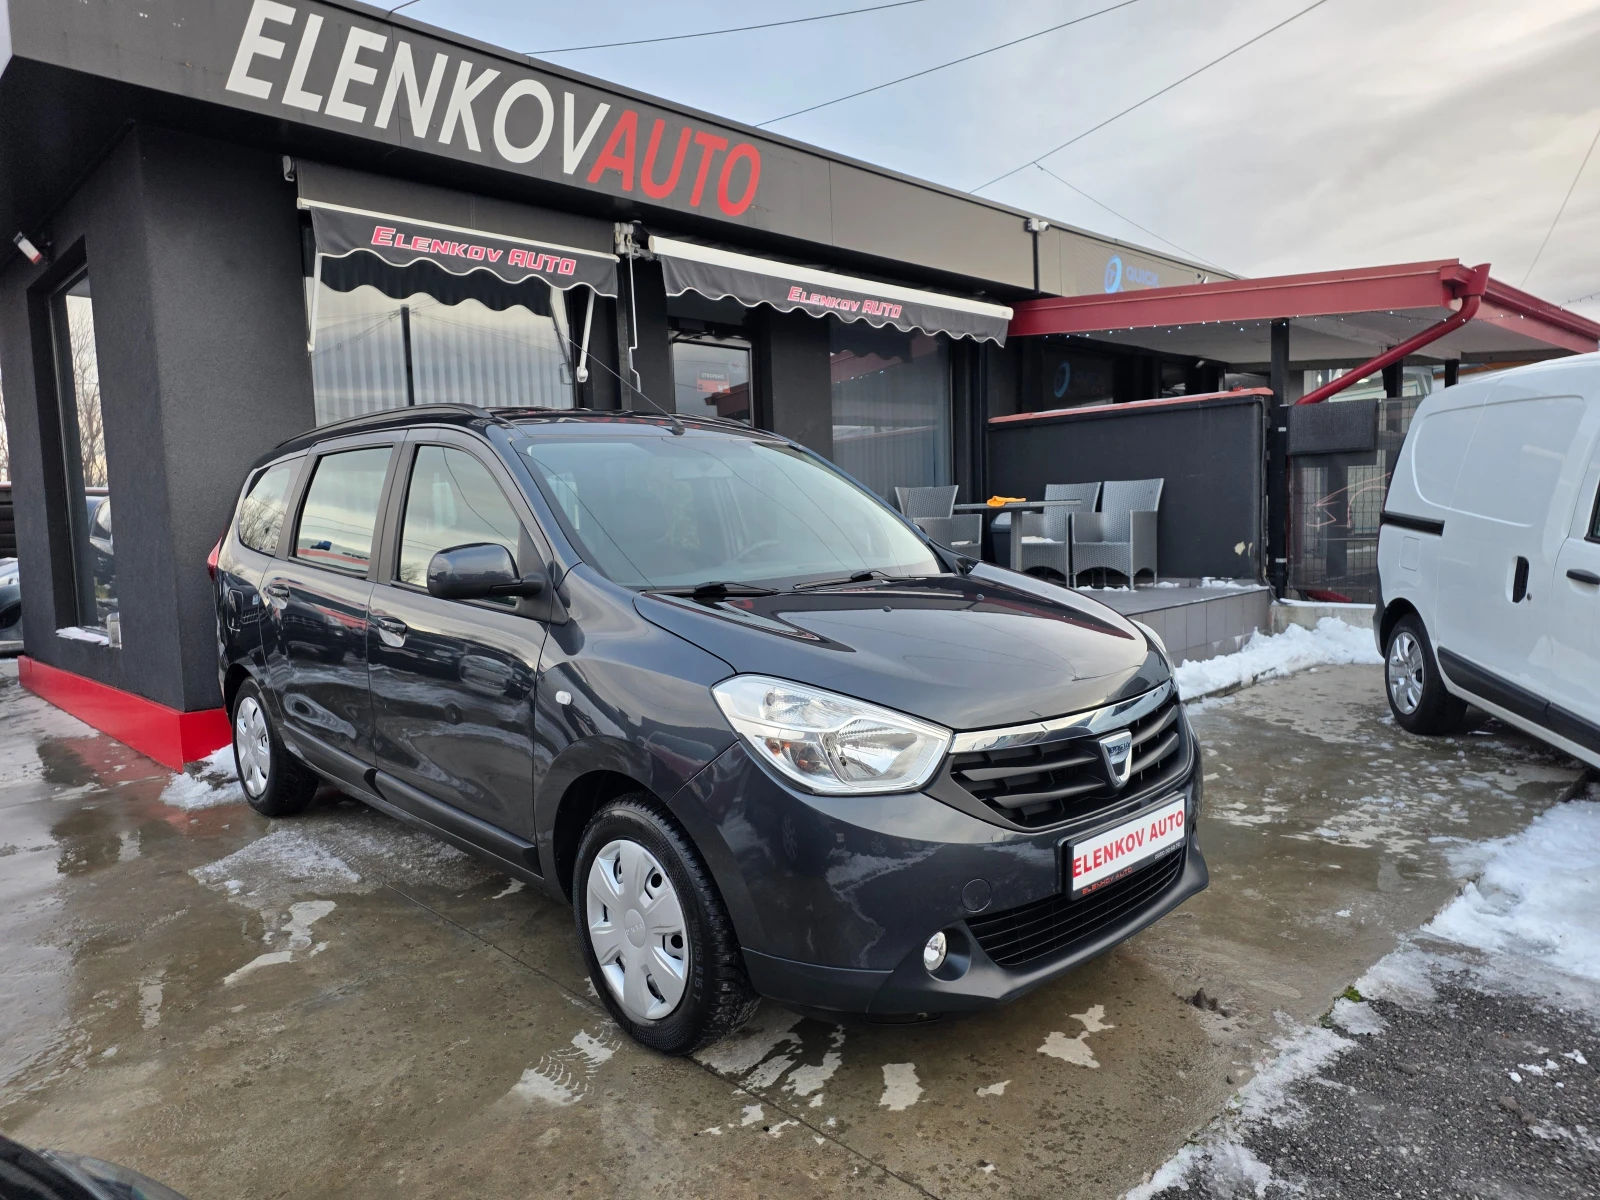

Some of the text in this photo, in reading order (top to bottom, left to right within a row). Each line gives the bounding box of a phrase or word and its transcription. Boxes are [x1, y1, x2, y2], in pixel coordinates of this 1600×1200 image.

[371, 226, 576, 275] ELENKOV AUTO
[787, 286, 902, 319] ELENKOV AUTO
[1072, 828, 1145, 878] ELENKOV
[1149, 810, 1184, 842] AUTO
